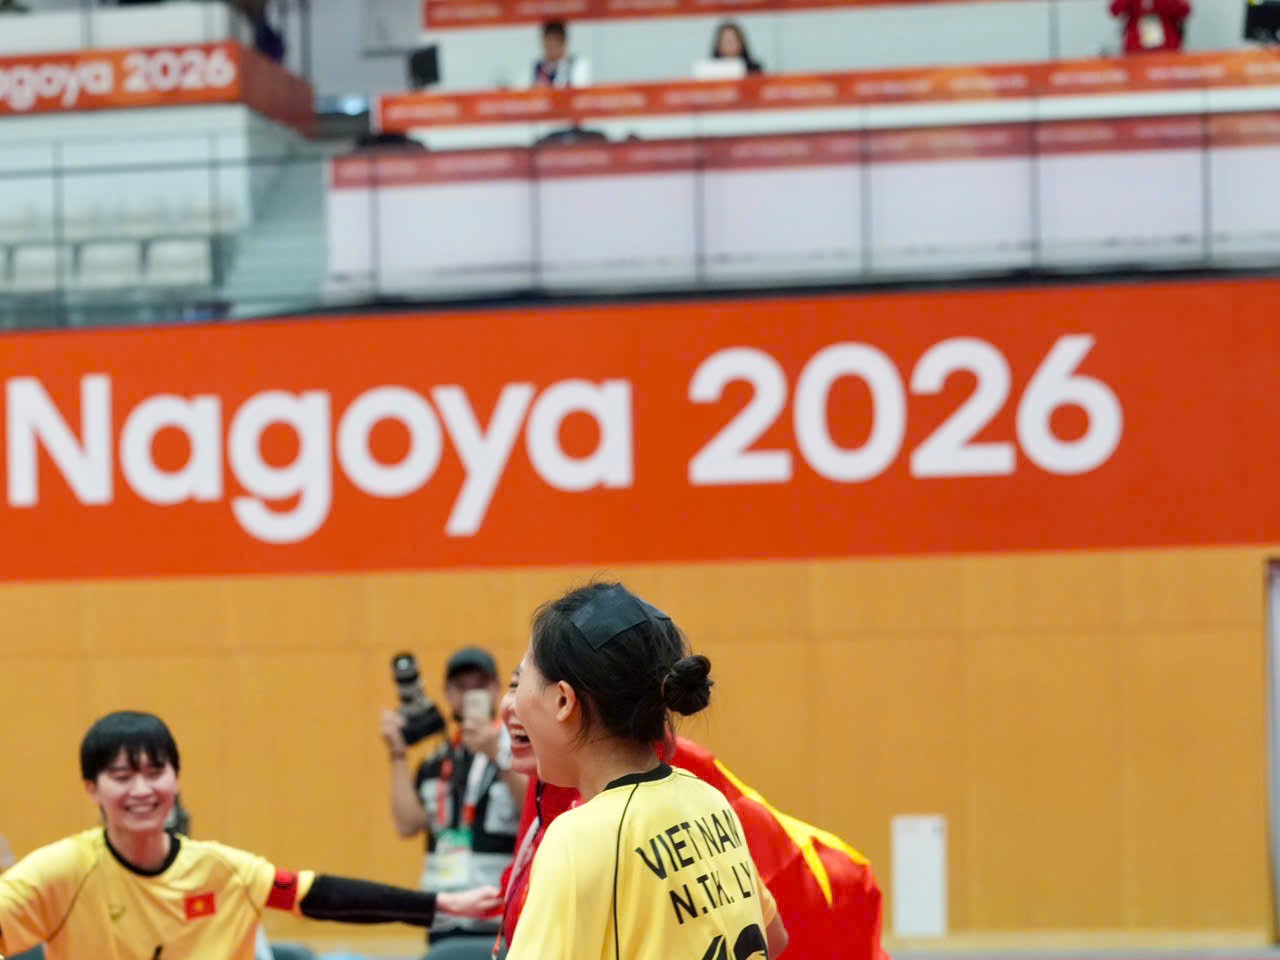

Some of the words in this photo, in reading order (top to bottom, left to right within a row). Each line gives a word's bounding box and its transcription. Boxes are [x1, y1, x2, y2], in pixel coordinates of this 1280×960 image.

[123, 49, 237, 94] 2026
[687, 333, 1123, 486] 2026
[635, 822, 702, 880] VIET
